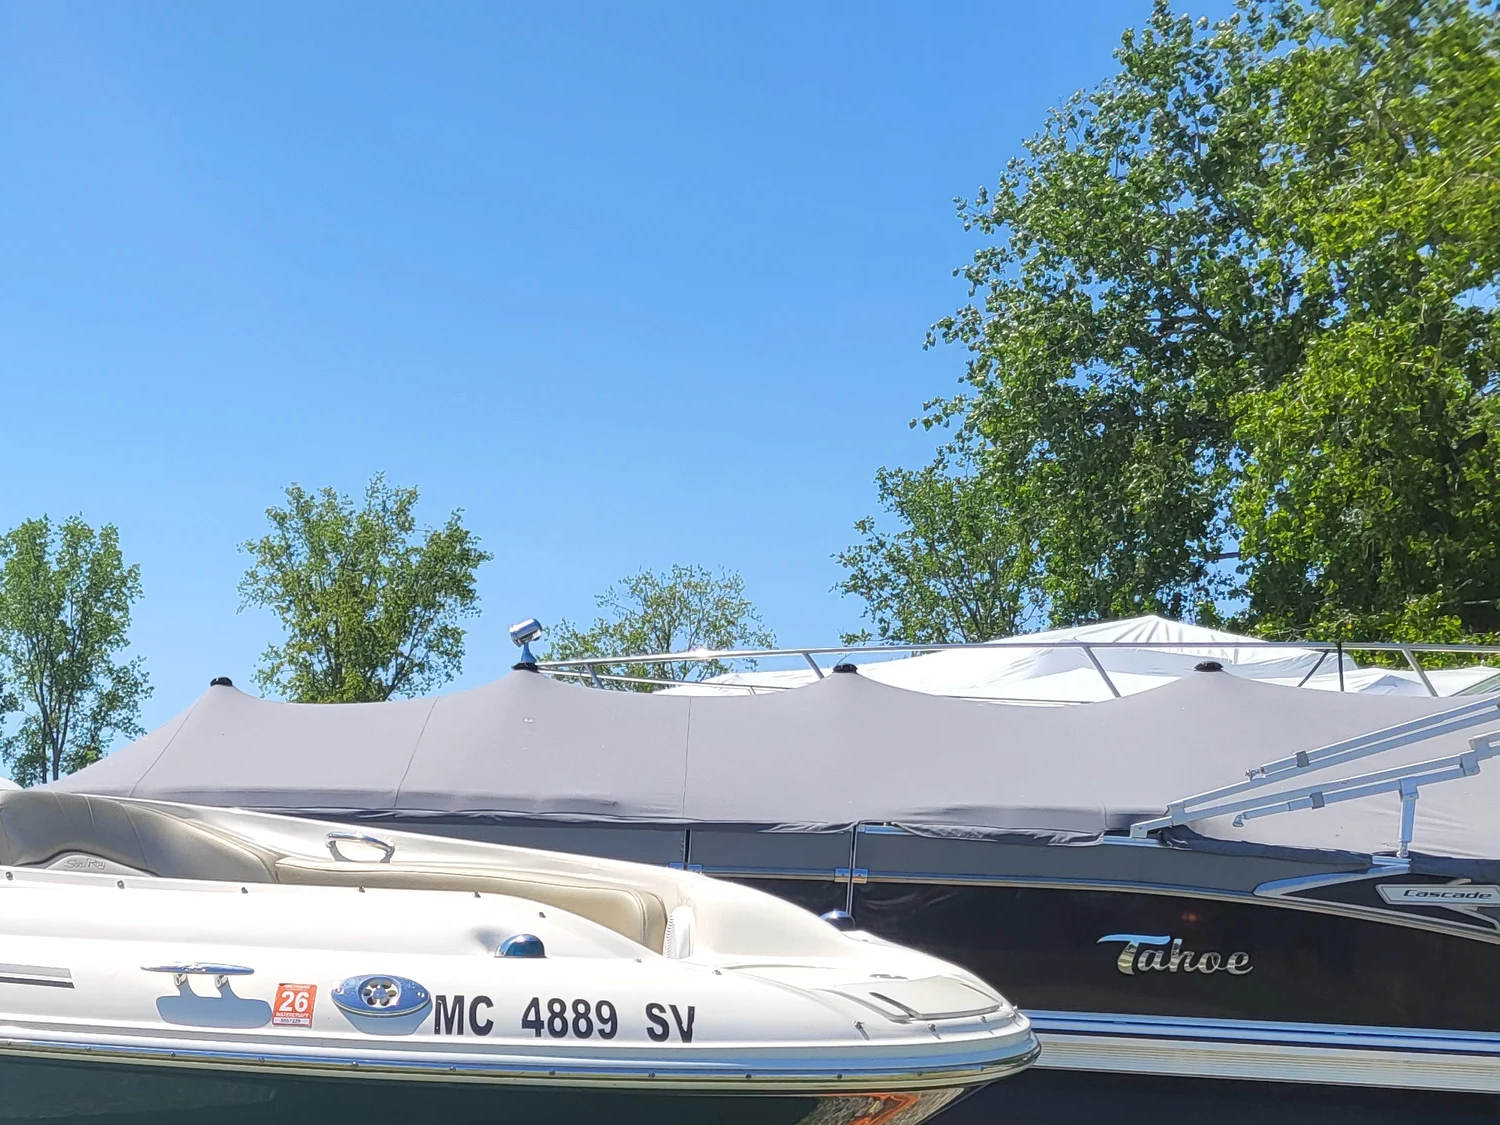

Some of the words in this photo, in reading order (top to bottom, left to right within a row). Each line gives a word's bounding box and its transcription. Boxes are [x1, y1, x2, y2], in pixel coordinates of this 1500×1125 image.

[1403, 889, 1493, 899] Cascade
[1096, 933, 1254, 976] Tahoe
[278, 990, 310, 1013] 26
[434, 994, 495, 1037] MC
[521, 997, 618, 1041] 4889
[645, 1002, 696, 1044] SV
